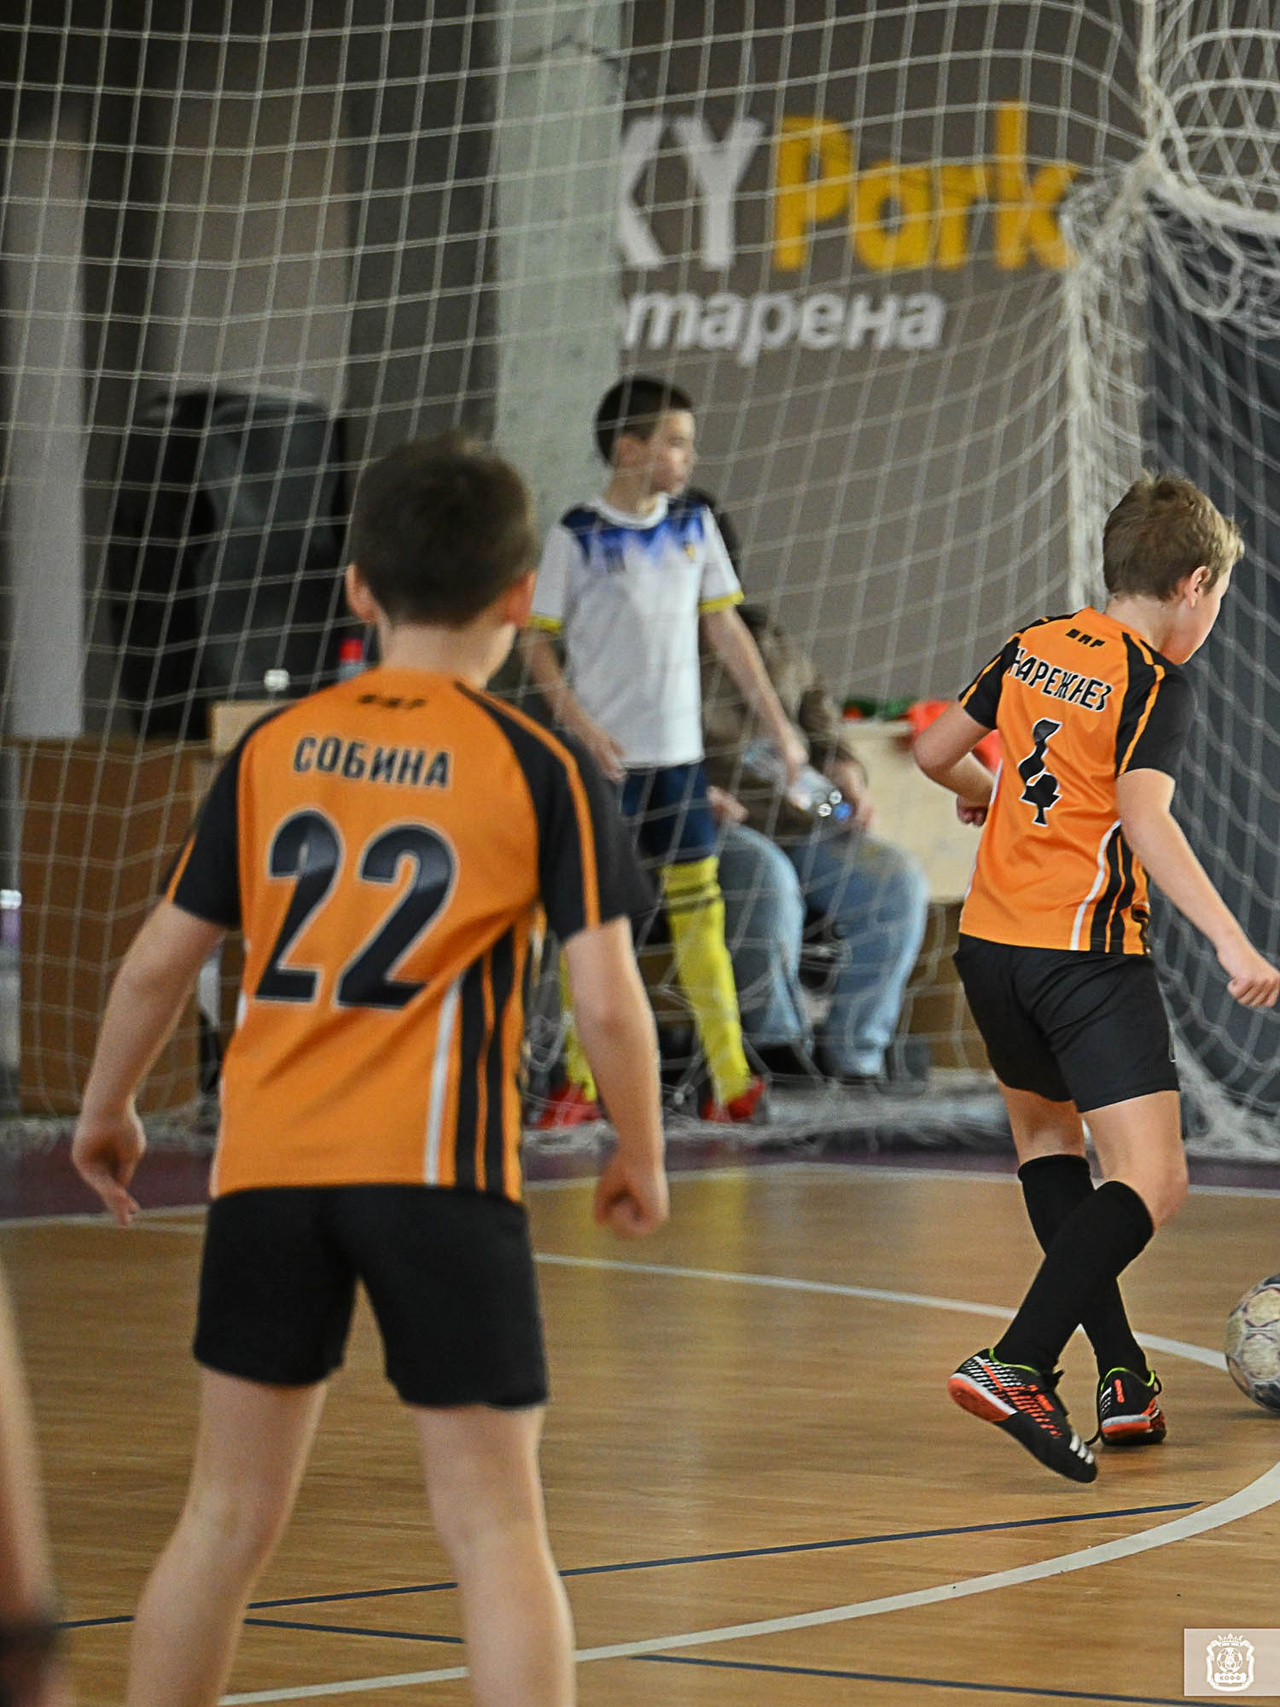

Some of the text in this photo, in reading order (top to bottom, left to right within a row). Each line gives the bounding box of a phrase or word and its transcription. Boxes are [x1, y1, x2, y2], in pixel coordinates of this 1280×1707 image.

[292, 734, 454, 788] СОБИНА
[1017, 717, 1063, 827] 4
[254, 807, 460, 1011] 22
